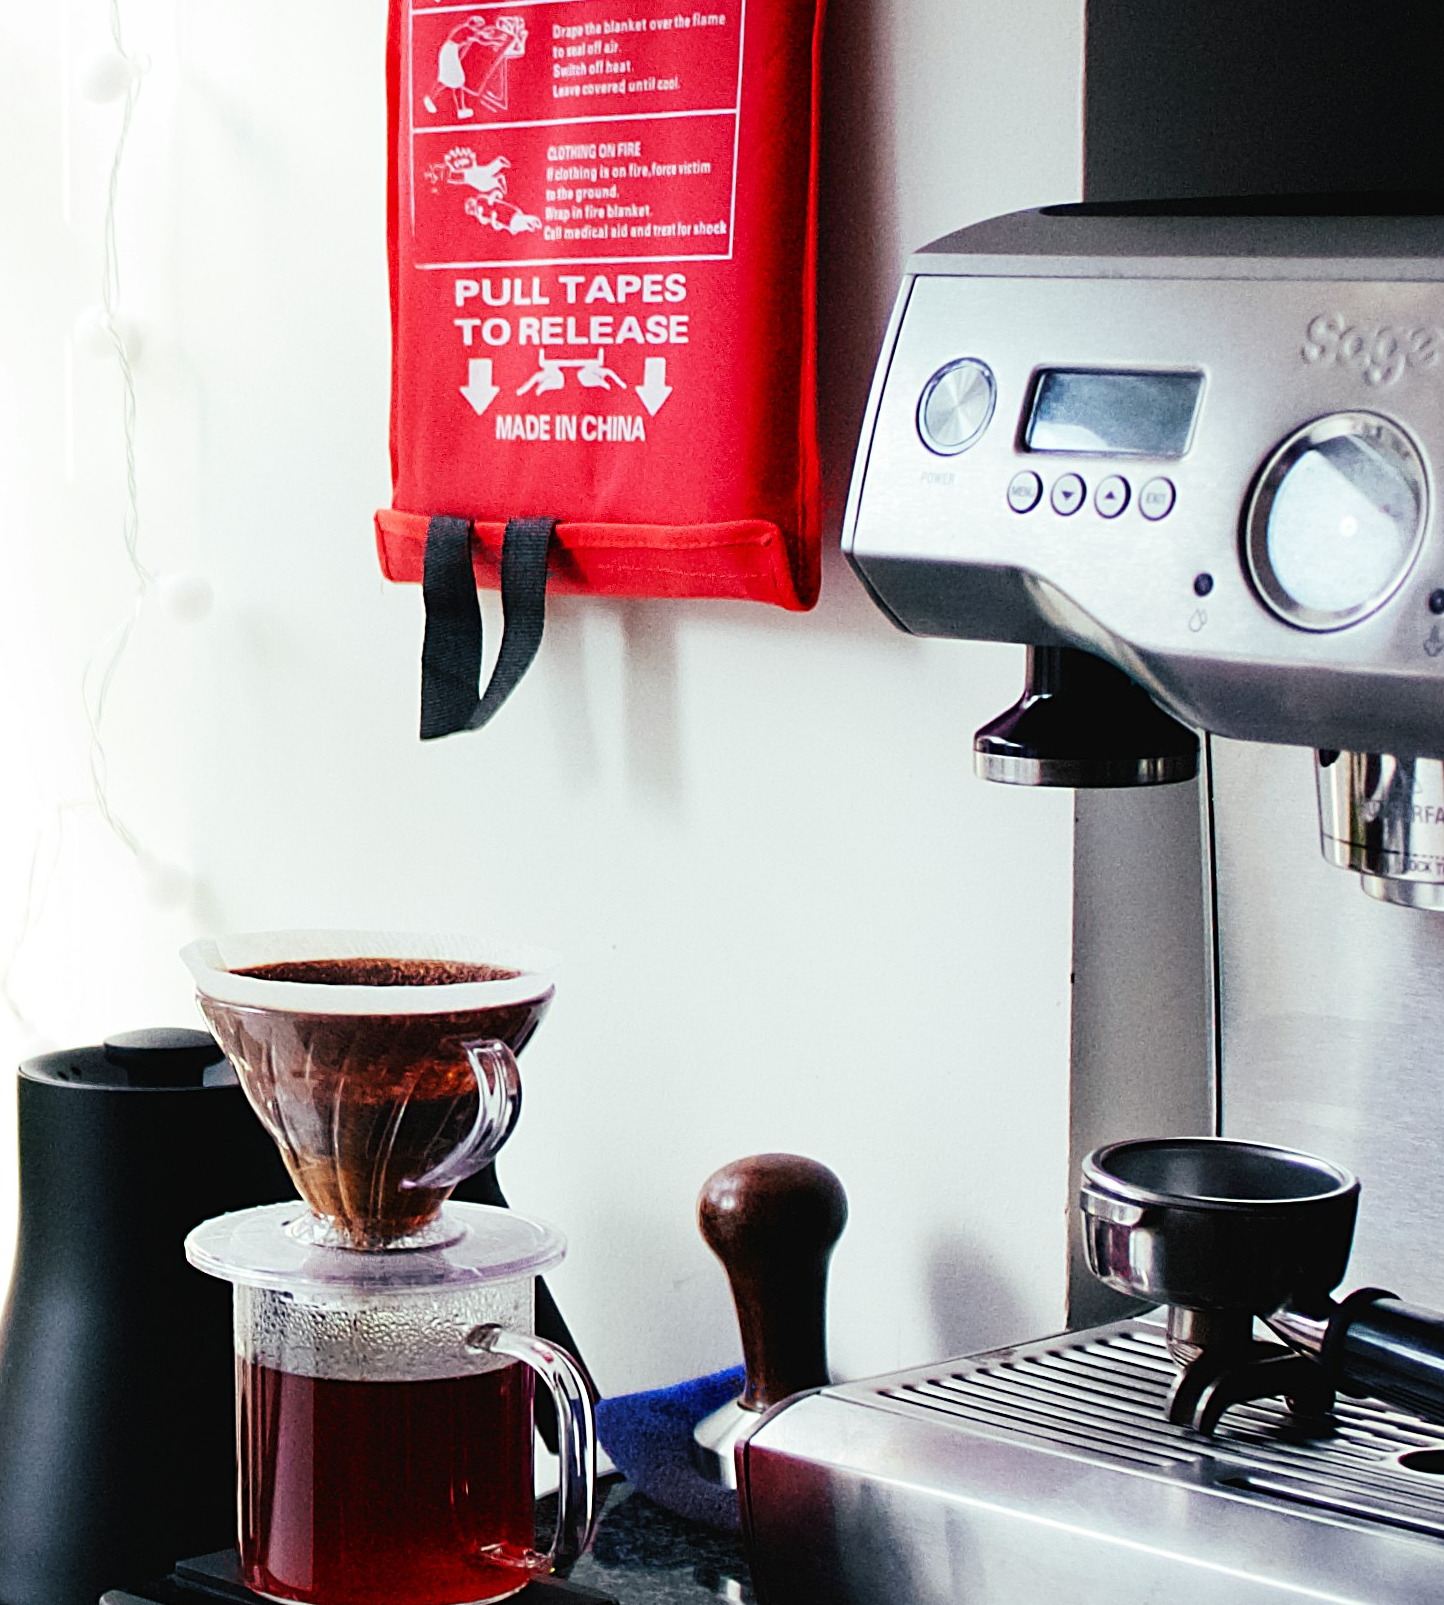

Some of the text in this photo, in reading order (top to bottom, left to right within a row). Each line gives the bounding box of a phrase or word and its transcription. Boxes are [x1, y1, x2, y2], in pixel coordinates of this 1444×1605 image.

[552, 12, 726, 39] Drape the blanket over the flame
[552, 39, 622, 59] to seal off air.
[553, 60, 635, 78] Switch off heat.
[553, 76, 680, 99] Leave covered until cool.
[547, 142, 641, 161] CLOTHING ON FIRE
[555, 165, 597, 182] clothing
[599, 165, 609, 179] is
[612, 166, 626, 178] on
[678, 160, 711, 174] victim
[557, 186, 573, 200] the
[576, 185, 620, 203] ground.
[572, 206, 582, 219] in
[585, 205, 605, 219] fire
[607, 204, 652, 218] blanket.
[544, 220, 727, 240] Call medical aid and treat for shock
[455, 273, 687, 307] PULL TAPES
[454, 315, 689, 346] TO RELEASE
[495, 414, 646, 442] MADE IN CHINA
[920, 471, 955, 486] POWER
